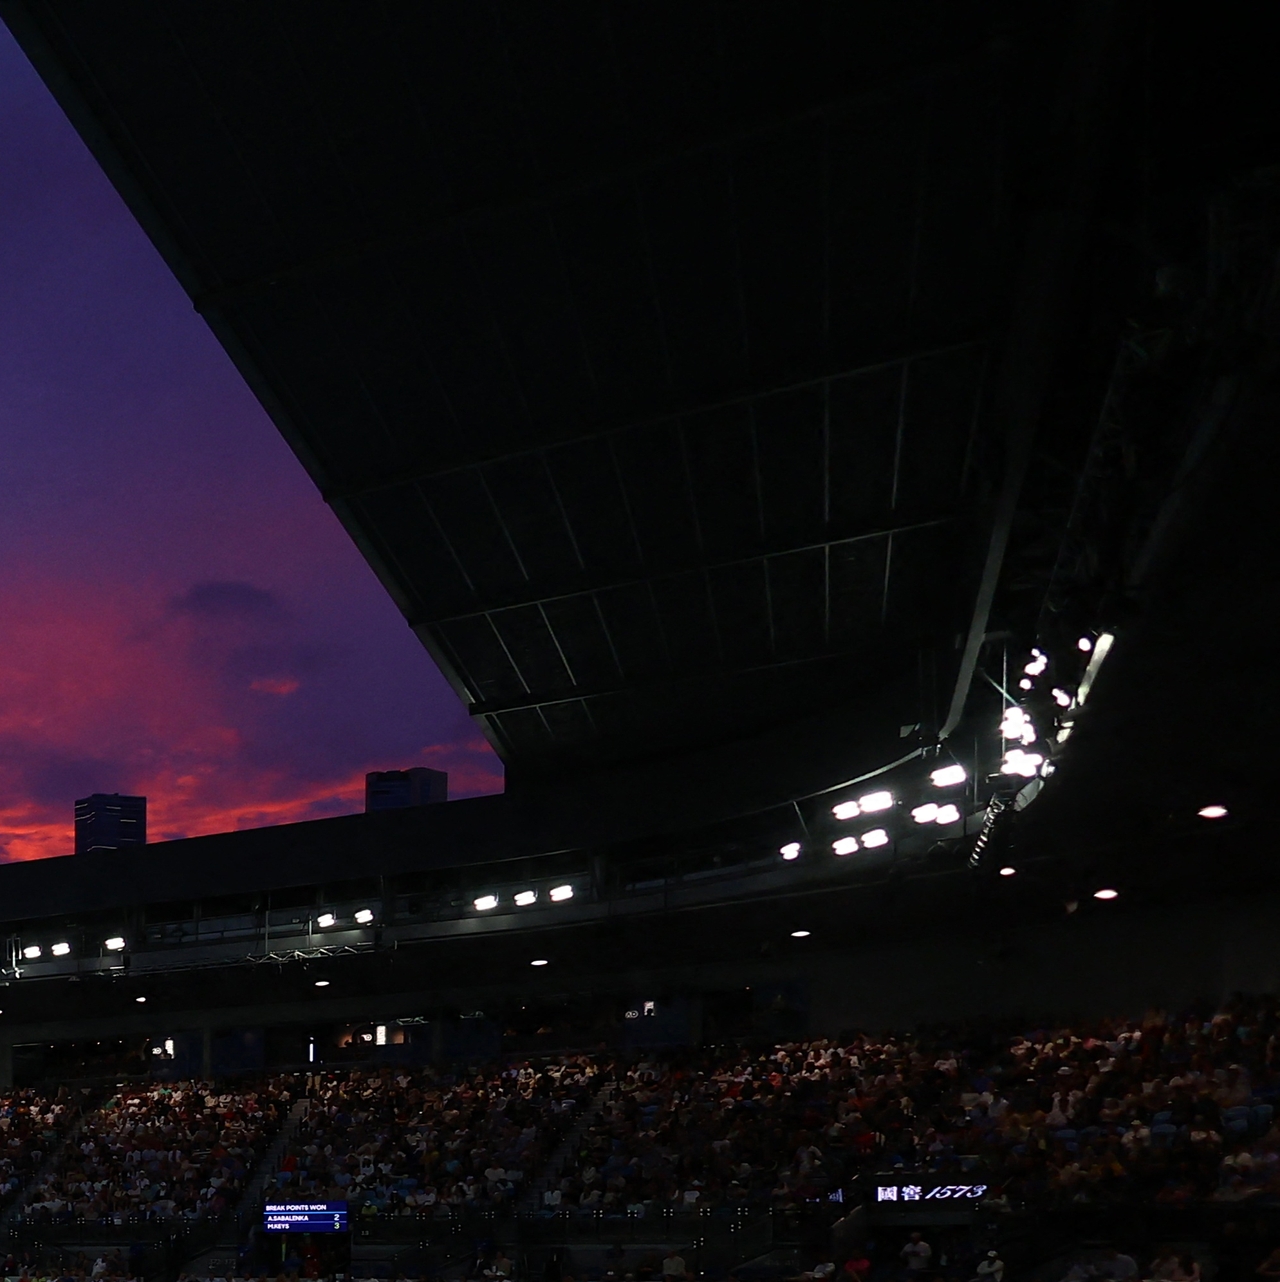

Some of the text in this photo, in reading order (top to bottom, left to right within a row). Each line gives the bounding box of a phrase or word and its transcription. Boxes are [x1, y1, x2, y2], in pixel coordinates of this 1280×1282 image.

[265, 1204, 285, 1212] BREAK
[267, 1213, 340, 1222] A.SABALENKA 2
[333, 1222, 340, 1230] 3
